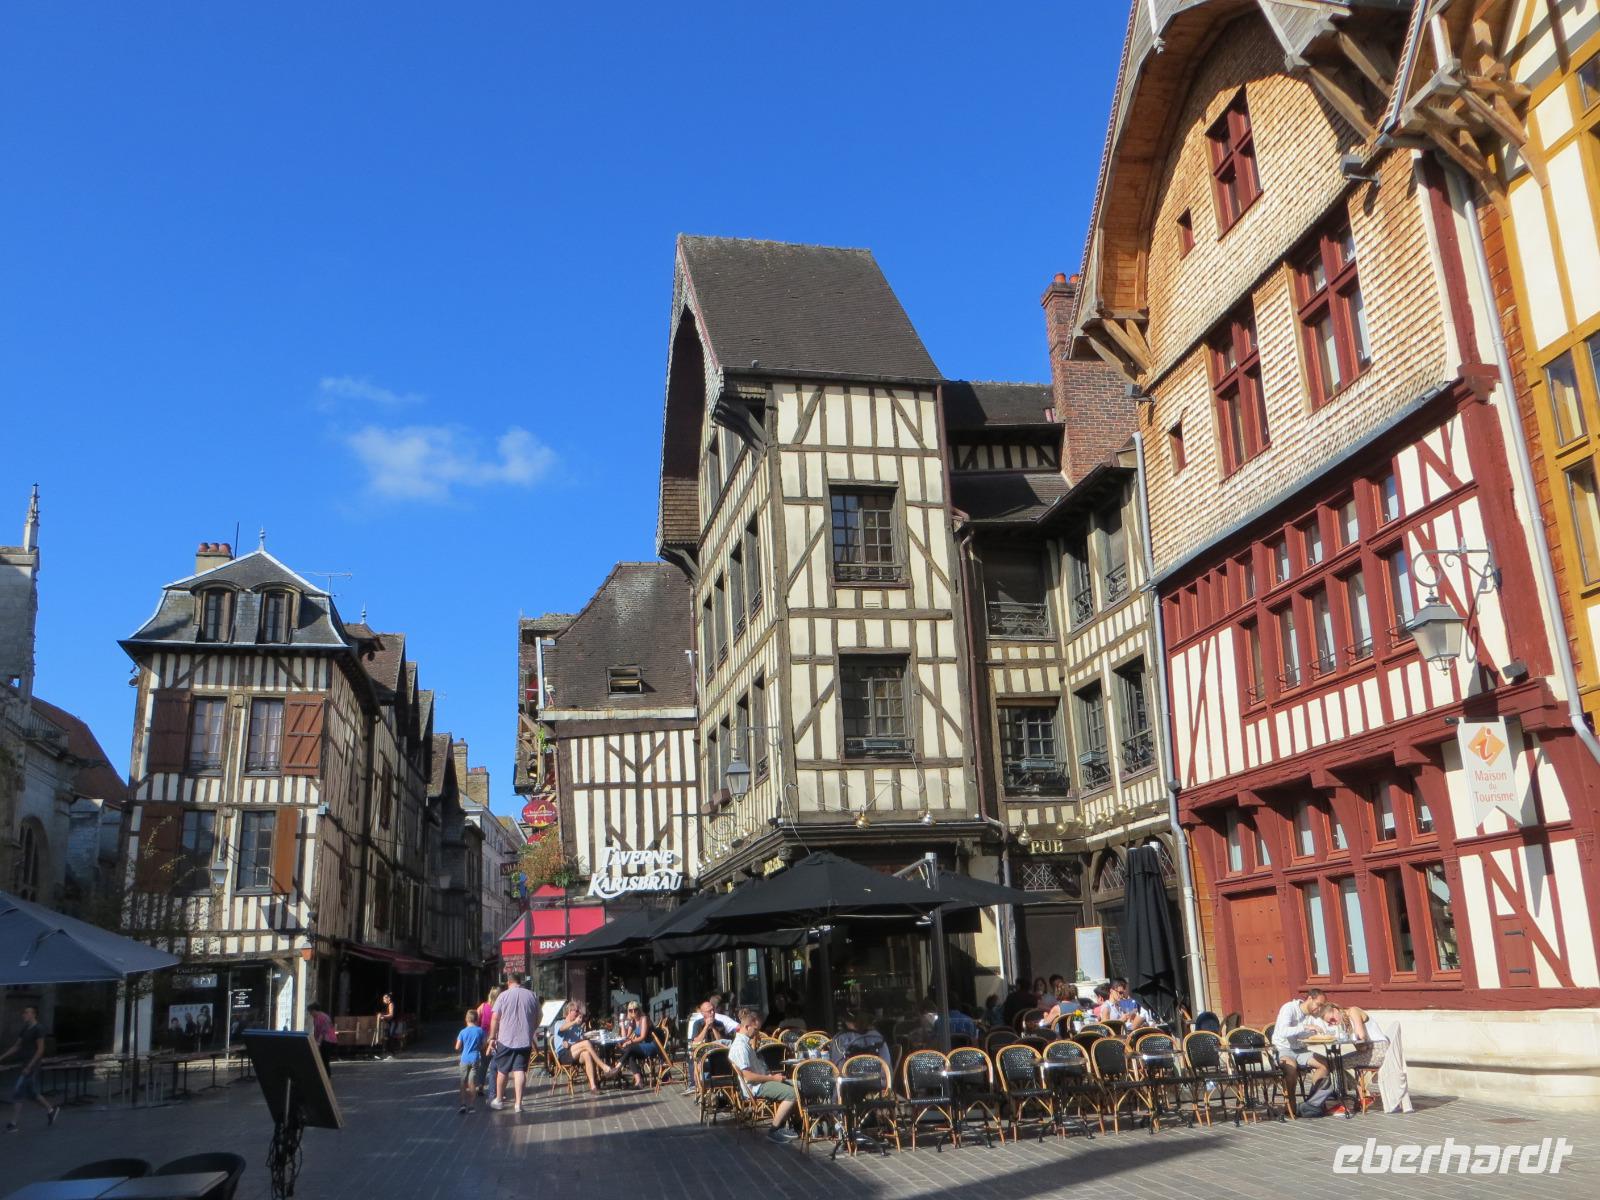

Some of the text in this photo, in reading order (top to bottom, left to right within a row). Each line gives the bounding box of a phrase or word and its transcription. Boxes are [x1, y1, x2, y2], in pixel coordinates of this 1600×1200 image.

[1474, 770, 1507, 781] Maison
[1488, 782, 1497, 790] du
[1473, 791, 1514, 803] Tourisme
[1030, 840, 1064, 854] PUB
[600, 847, 675, 867] TAVERNE
[539, 939, 576, 949] BRAS
